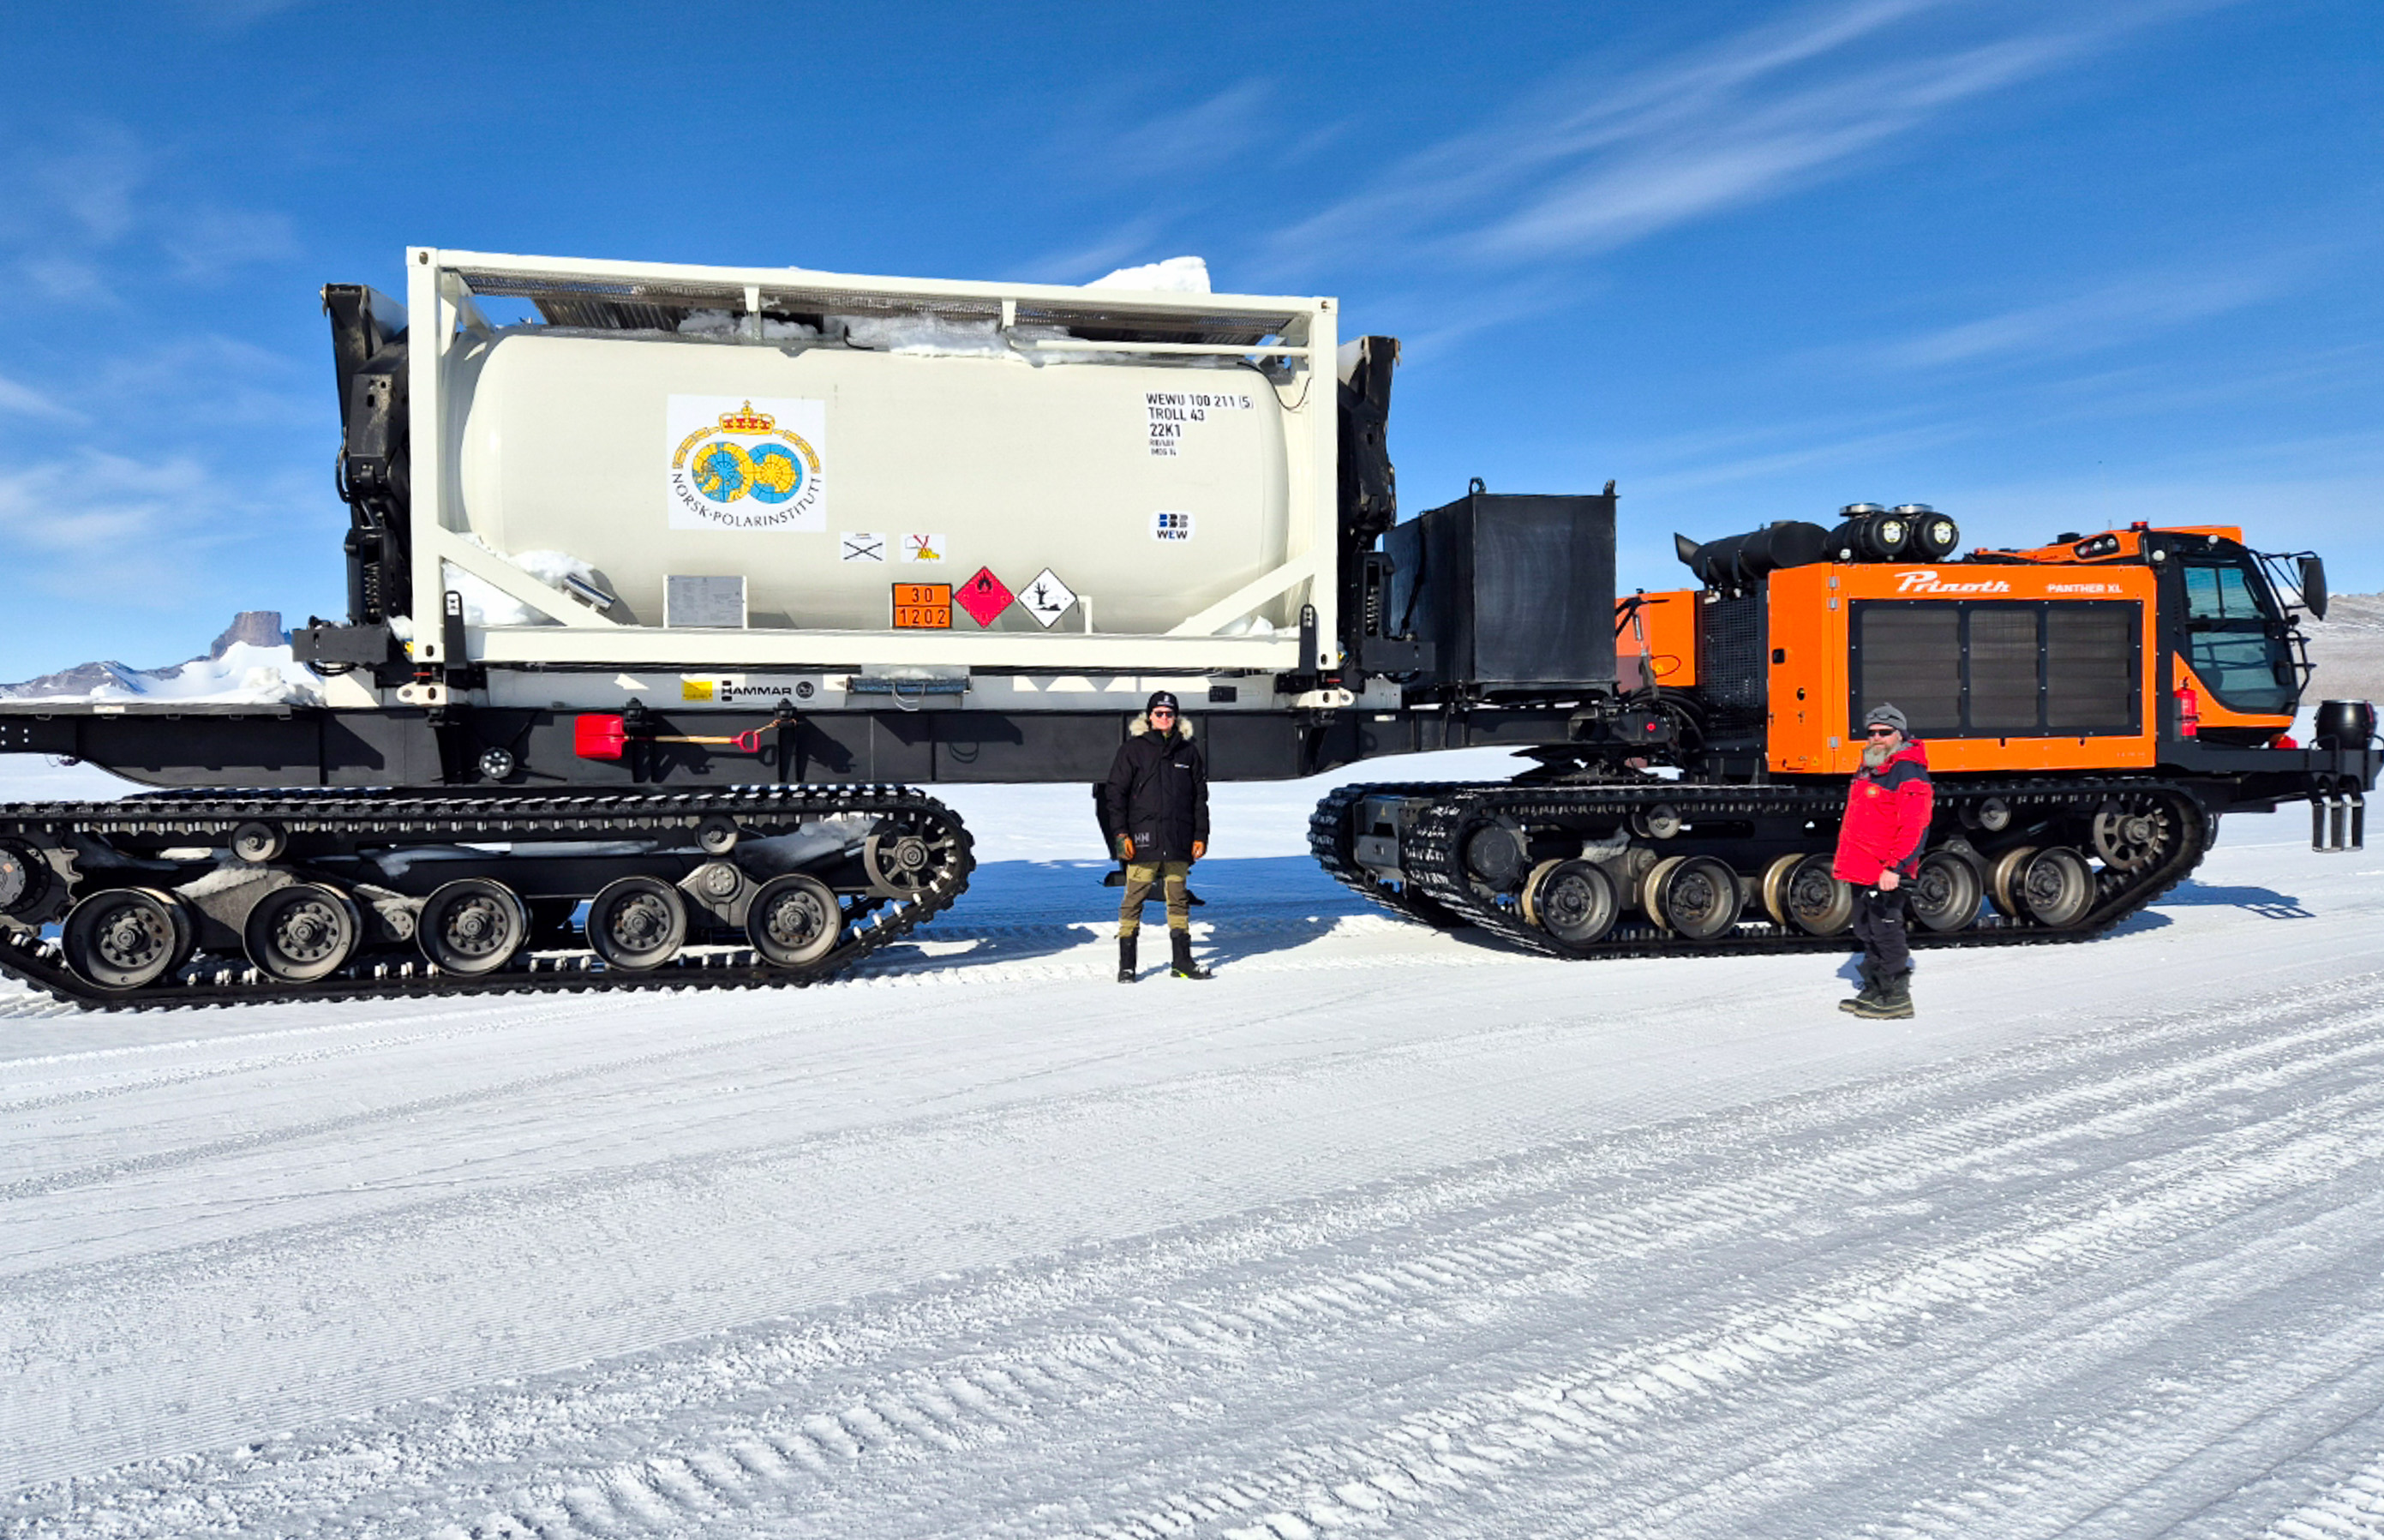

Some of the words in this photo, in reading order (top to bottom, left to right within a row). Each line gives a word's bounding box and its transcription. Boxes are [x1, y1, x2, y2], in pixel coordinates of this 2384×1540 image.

[1146, 392, 1185, 405] WEWU
[1189, 394, 1211, 406] 100
[1213, 395, 1235, 407] 211
[1148, 407, 1187, 421] TROLL
[1190, 409, 1205, 421] 43
[1149, 423, 1181, 437] 22K1
[1157, 530, 1189, 539] WEW
[1894, 571, 2010, 593] Prinoth
[2046, 584, 2105, 593] PANTHER
[2107, 584, 2123, 593] XL
[911, 587, 933, 602] 30
[899, 609, 946, 625] 1202
[722, 684, 792, 698] HAMMAR
